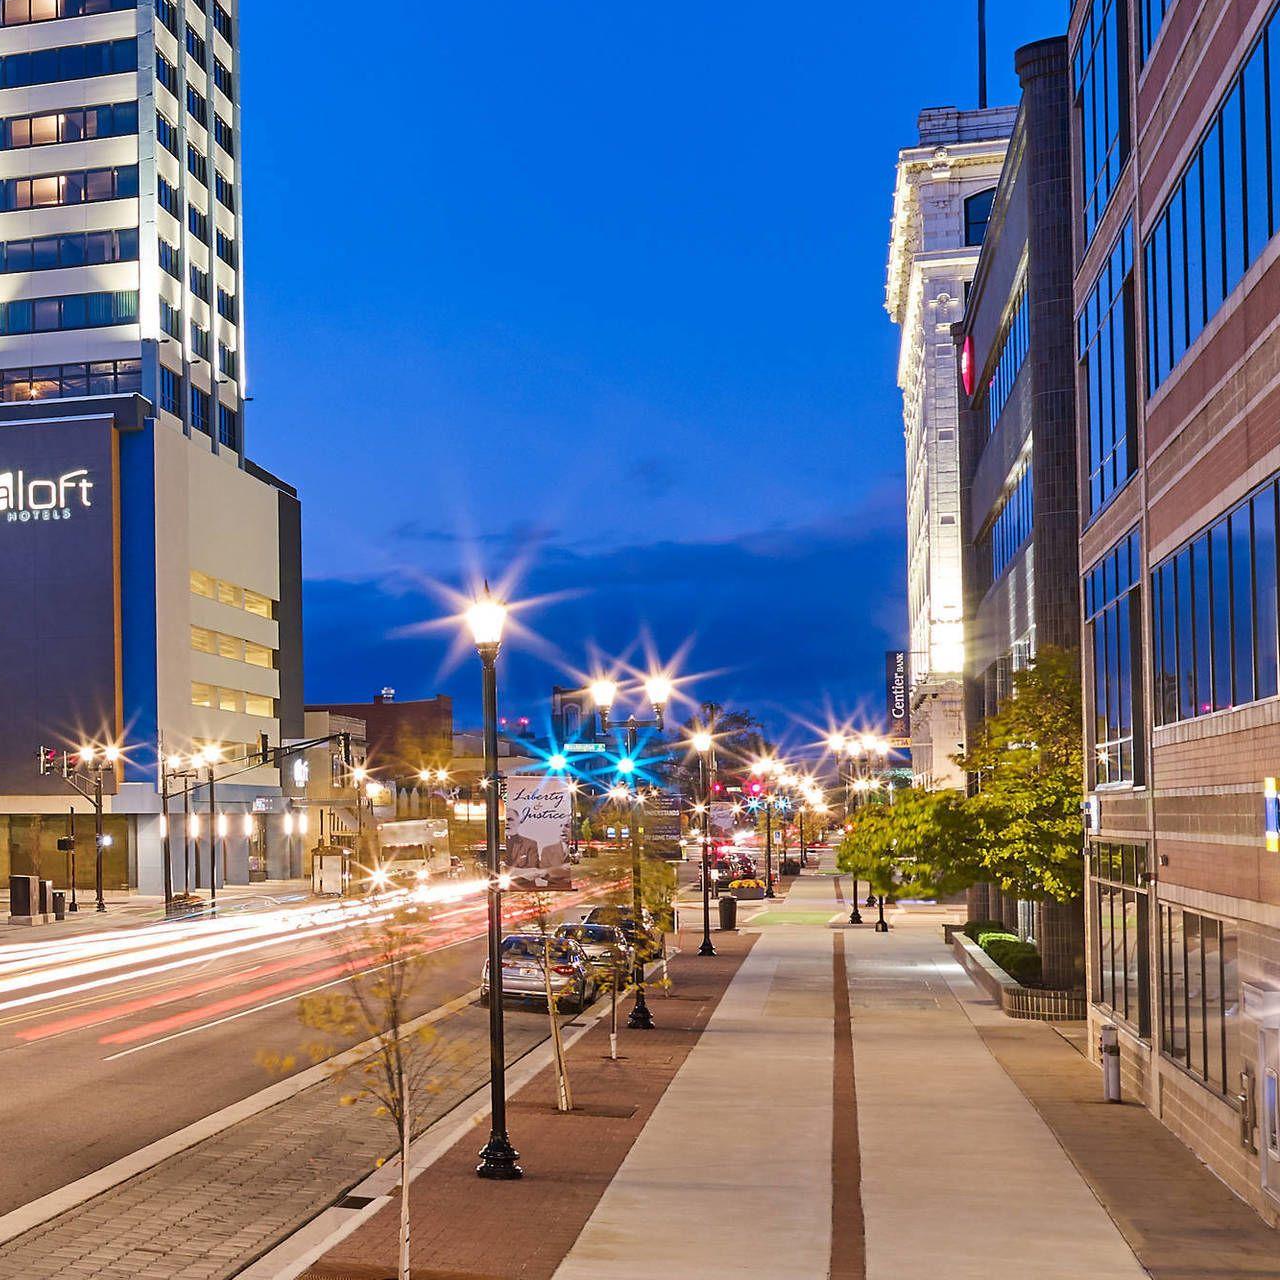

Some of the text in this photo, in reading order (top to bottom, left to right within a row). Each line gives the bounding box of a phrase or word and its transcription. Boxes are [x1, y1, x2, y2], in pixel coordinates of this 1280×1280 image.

[7, 507, 72, 522] HOTELS
[892, 652, 905, 719] Centier BANK
[513, 787, 564, 808] Liberty
[520, 806, 568, 823] Justice
